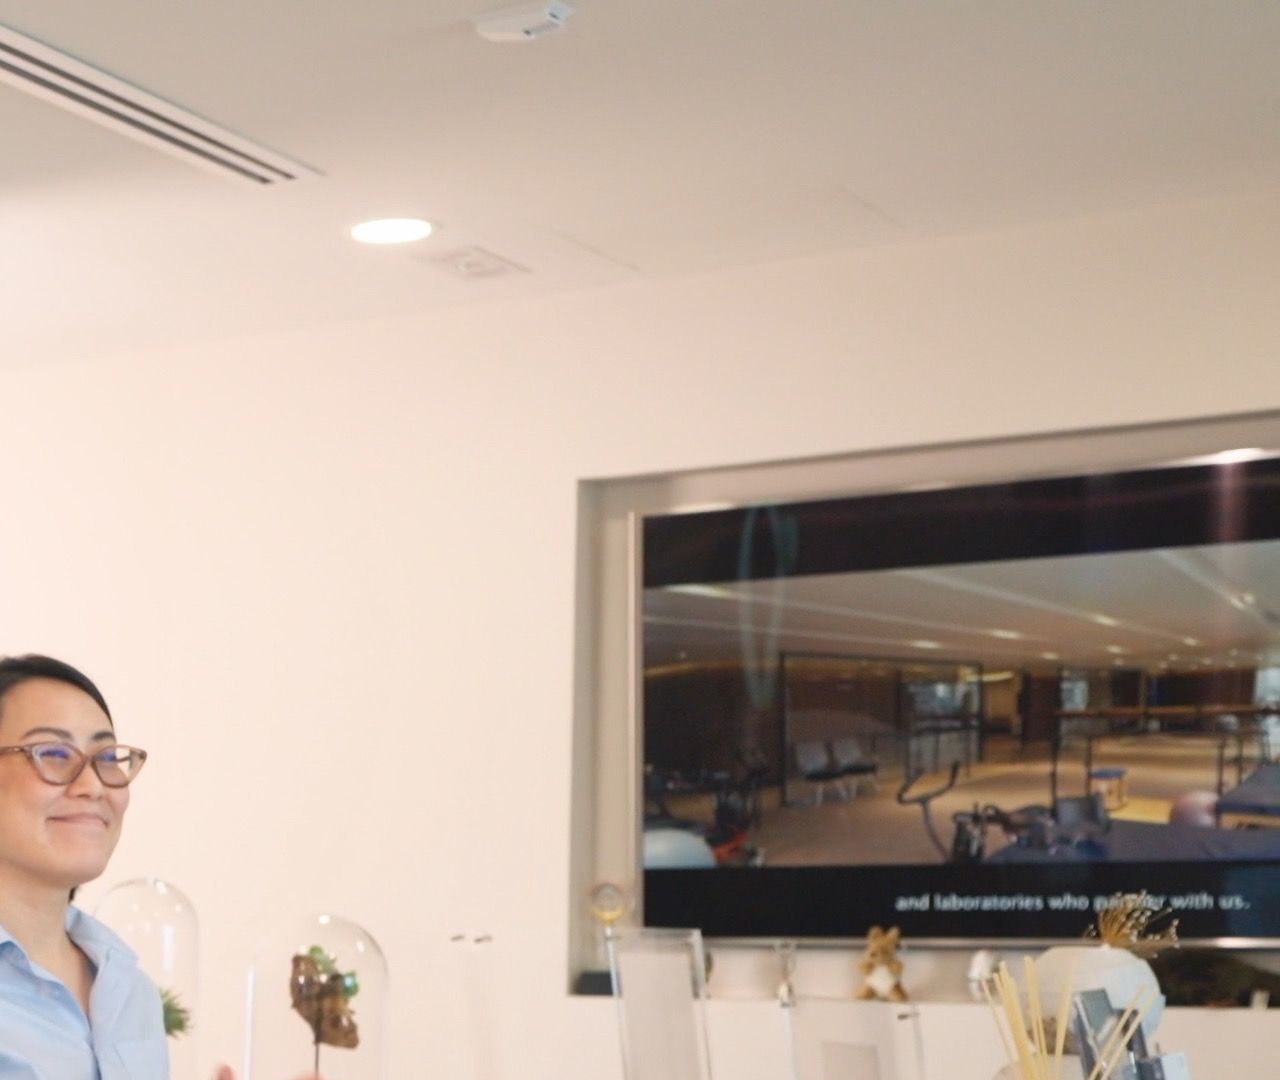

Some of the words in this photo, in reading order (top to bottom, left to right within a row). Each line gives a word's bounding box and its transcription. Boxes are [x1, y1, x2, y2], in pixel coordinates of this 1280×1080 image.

[895, 894, 930, 911] and
[933, 893, 1044, 911] laboratories
[1047, 892, 1090, 910] who
[1092, 894, 1167, 913] paer
[1169, 892, 1215, 910] with
[1218, 894, 1252, 910] us.
